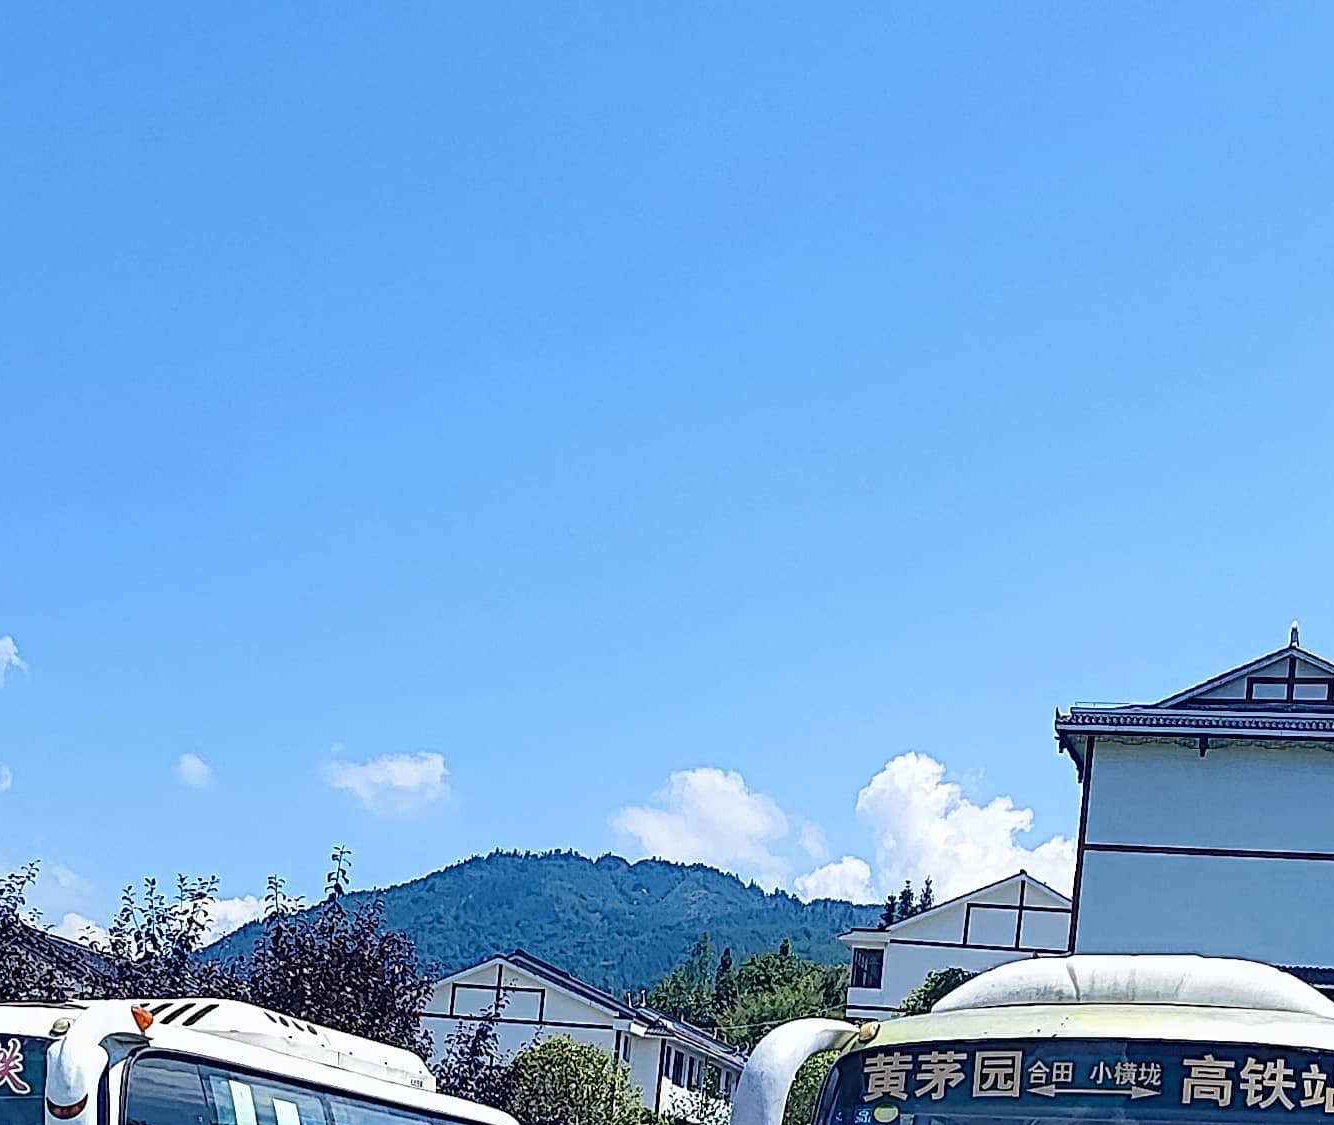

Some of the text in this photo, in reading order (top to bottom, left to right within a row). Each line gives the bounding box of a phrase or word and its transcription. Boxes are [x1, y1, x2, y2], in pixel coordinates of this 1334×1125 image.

[863, 1050, 1023, 1102] 黄茅园
[1027, 1061, 1074, 1084] 合田
[1090, 1061, 1162, 1086] 小横垅
